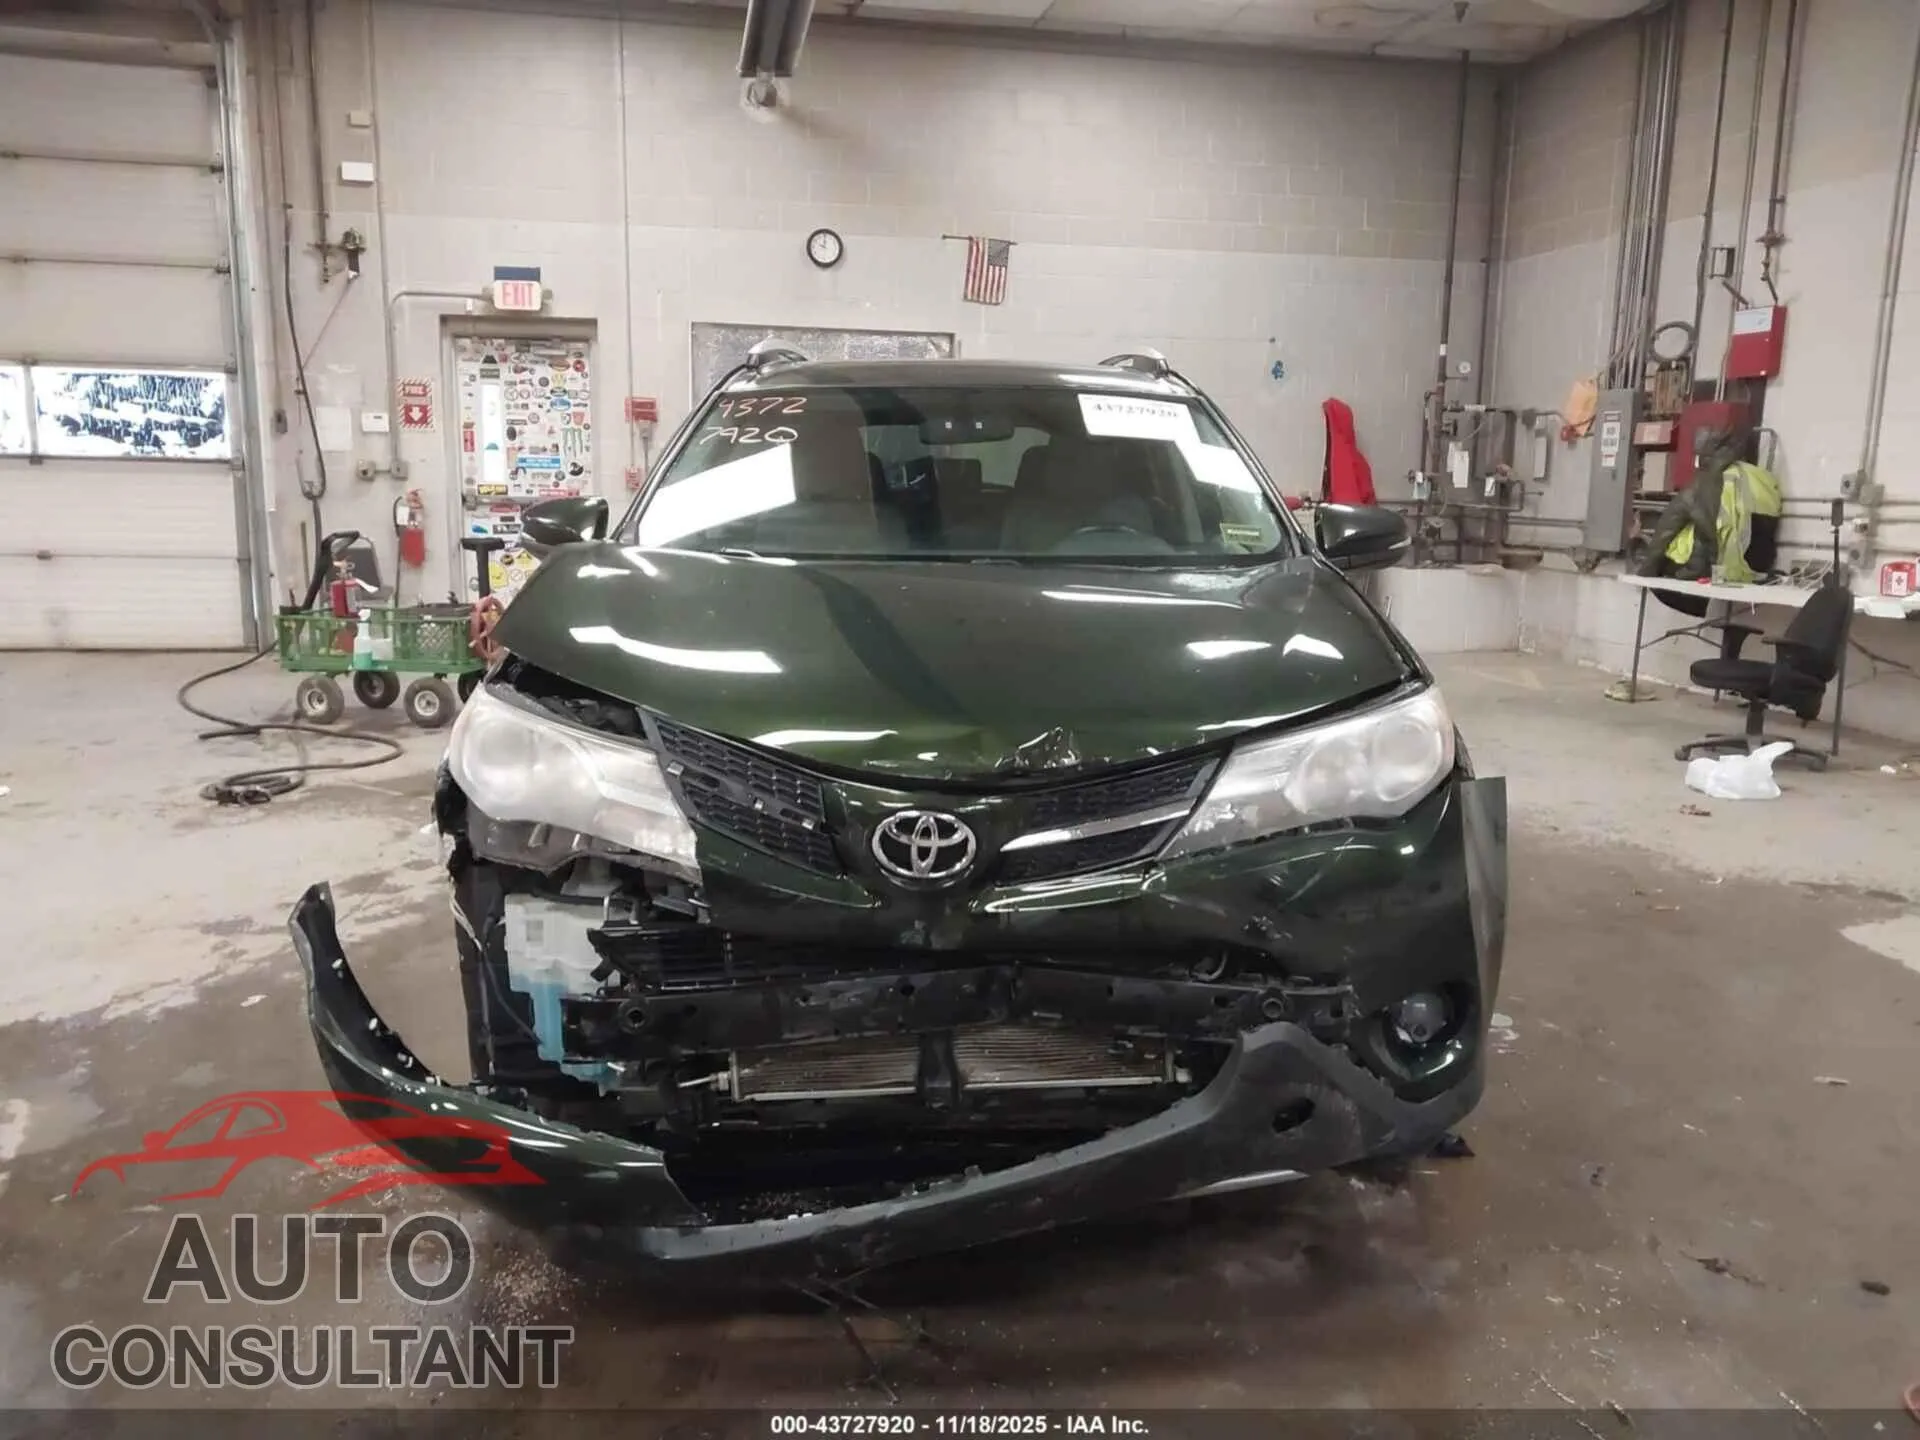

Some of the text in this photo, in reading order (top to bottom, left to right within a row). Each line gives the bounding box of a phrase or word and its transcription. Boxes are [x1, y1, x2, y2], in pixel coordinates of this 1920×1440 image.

[502, 282, 534, 307] EXIT
[718, 396, 808, 420] 4372
[698, 425, 800, 446] 7920
